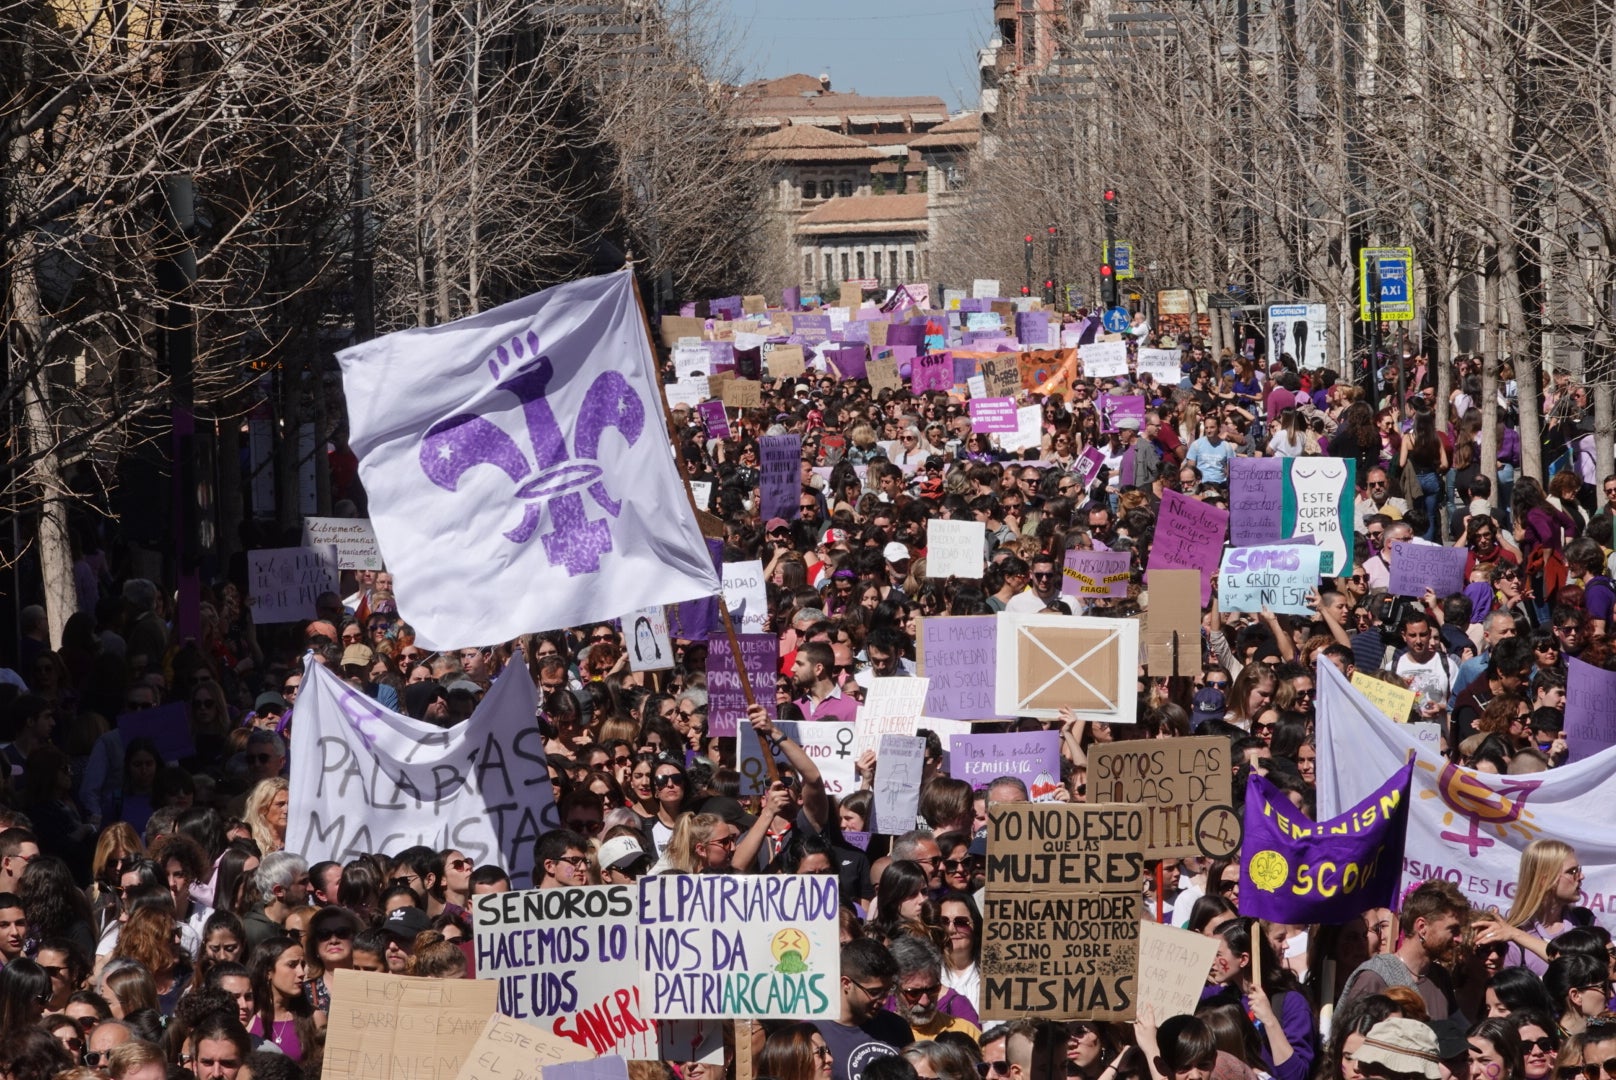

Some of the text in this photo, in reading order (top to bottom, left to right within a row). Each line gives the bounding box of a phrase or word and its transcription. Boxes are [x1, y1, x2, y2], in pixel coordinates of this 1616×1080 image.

[1381, 285, 1401, 296] AXI
[1303, 493, 1333, 502] ESTE
[1299, 507, 1337, 518] CUERPO
[1300, 523, 1314, 533] ES
[1224, 548, 1301, 574] SOMOS
[723, 577, 758, 589] RIDAD
[1067, 569, 1095, 586] FRAGIL
[1227, 575, 1241, 588] EL
[1247, 570, 1280, 587] GRITO
[1081, 586, 1110, 594] FRAGIL
[1260, 589, 1277, 606] NO
[1282, 587, 1312, 607] ESTA
[928, 625, 997, 642] EL MACHISM
[710, 639, 776, 655] NOS UIEREN
[925, 647, 988, 668] ENFERMEDAD
[725, 654, 763, 669] MSAS
[707, 671, 777, 689] PORQE NOS
[954, 668, 995, 688] SOCIAL
[1418, 729, 1439, 741] CASA
[799, 744, 832, 758] CIDO
[1097, 747, 1221, 779] SOMOS LAS
[1095, 773, 1221, 804] HIJAS DE
[988, 811, 1143, 841] YO NO DESEO
[1147, 803, 1195, 849] ITH
[1043, 841, 1100, 852] QUE LAS
[987, 853, 1144, 883] MUJERES
[1402, 855, 1463, 888] ISMO
[1467, 875, 1490, 895] ES
[478, 885, 632, 926] SEÑOROS
[639, 875, 838, 925] EL PATRIARCADO
[985, 896, 1136, 920] TENGAN PODER
[986, 920, 1139, 941] SOBRE NOSOTROS
[478, 924, 590, 970] HACEMOS
[598, 924, 627, 962] LO
[645, 928, 701, 971] NOS
[712, 929, 748, 971] DA
[1004, 943, 1112, 960] SINO SOBRE
[1039, 960, 1096, 976] ELLAS
[366, 980, 452, 1004] HOY EN
[497, 974, 527, 1019] UE
[654, 973, 829, 1014] PATRIARCADAS
[985, 975, 1133, 1013] MISMAS
[351, 1009, 414, 1031] BARRIO
[478, 1051, 501, 1074] EL
